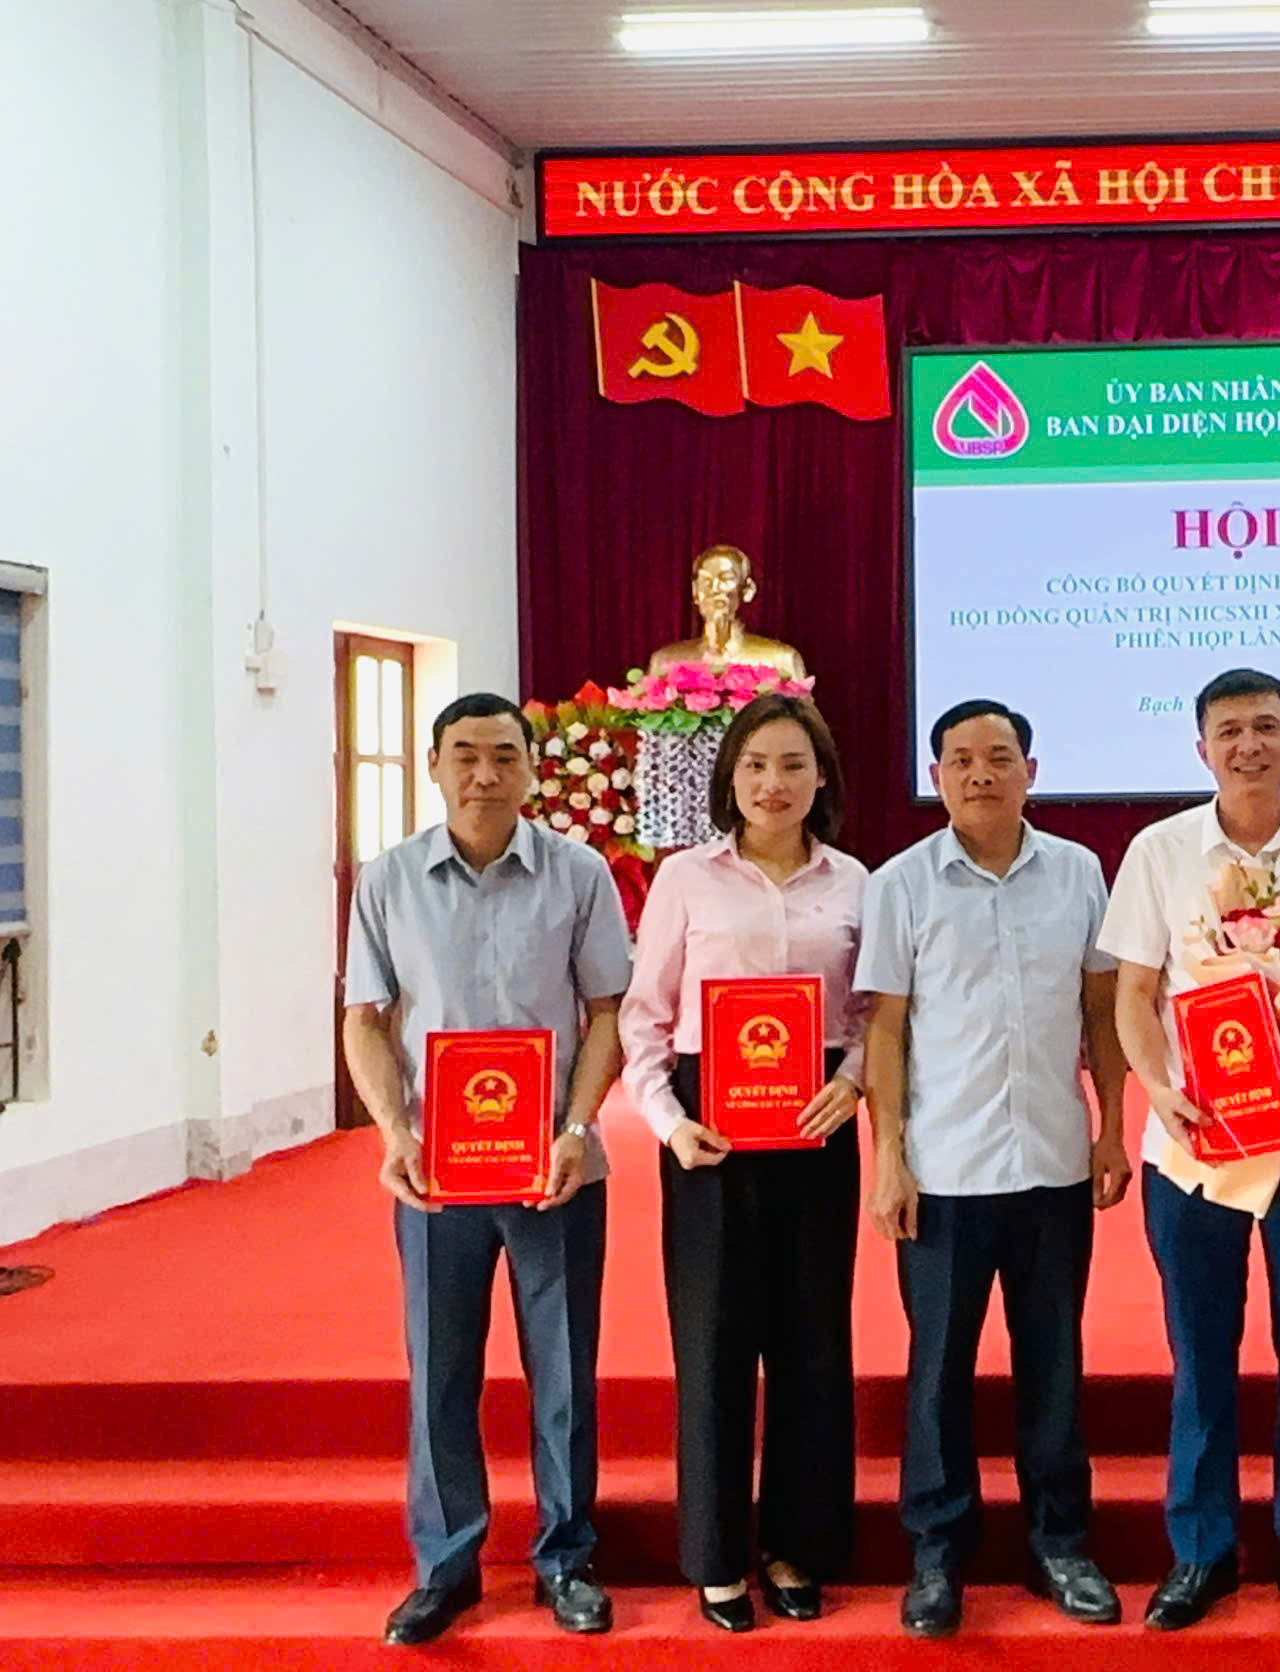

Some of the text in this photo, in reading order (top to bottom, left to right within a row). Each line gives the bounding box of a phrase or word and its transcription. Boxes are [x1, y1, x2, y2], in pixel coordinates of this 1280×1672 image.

[575, 168, 719, 217] NƯỚC
[733, 170, 875, 221] CỘNG
[890, 161, 1000, 209] HÒA
[1010, 160, 1081, 207] XÃ
[1096, 161, 1190, 213] HỘI
[1106, 377, 1143, 404] ỦY
[1150, 381, 1204, 404] BAN
[1047, 415, 1099, 437] BAN
[1107, 413, 1153, 440] ĐẠI
[1163, 409, 1226, 439] DIỆN
[1172, 501, 1280, 559] HỘI
[1046, 573, 1110, 594] CÔNG
[1117, 572, 1147, 593] BỐ
[1152, 570, 1228, 595] QUYẾT
[950, 608, 989, 630] HỘI
[1066, 602, 1128, 628] QUẢN
[1136, 607, 1172, 626] TRỊ
[1178, 605, 1268, 622] NHCSXH
[1115, 628, 1181, 648] PHIÊN
[1189, 630, 1233, 651] HỌP
[1138, 696, 1183, 716] Bạch
